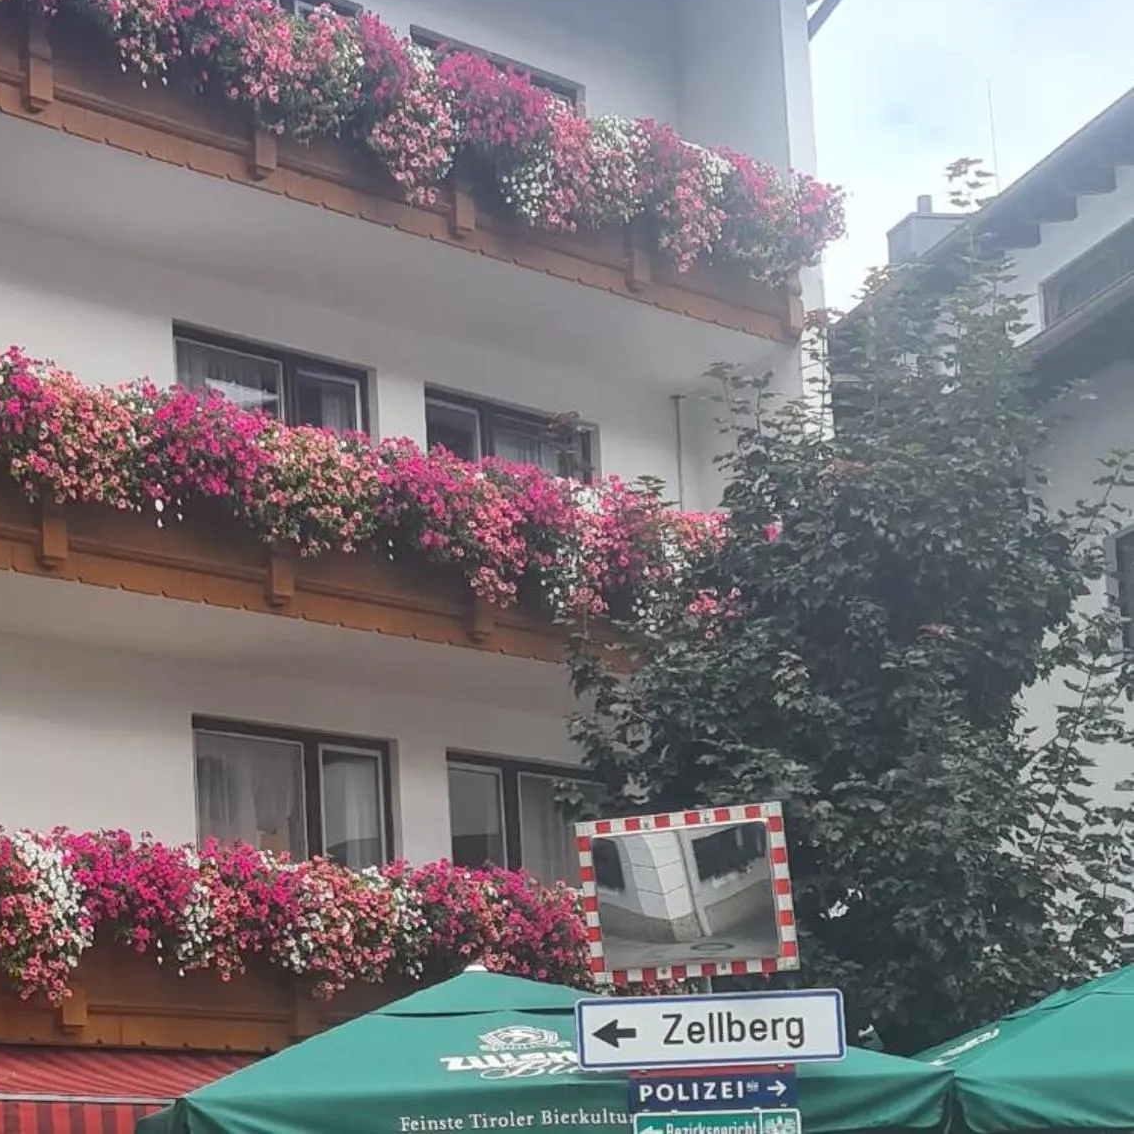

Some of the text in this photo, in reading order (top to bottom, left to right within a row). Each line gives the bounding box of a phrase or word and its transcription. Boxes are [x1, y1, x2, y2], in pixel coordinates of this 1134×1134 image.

[661, 1011, 804, 1049] Zellberg
[639, 1080, 743, 1103] POLIZEI
[399, 1115, 464, 1132] Feinste
[468, 1110, 535, 1129] Tiroler
